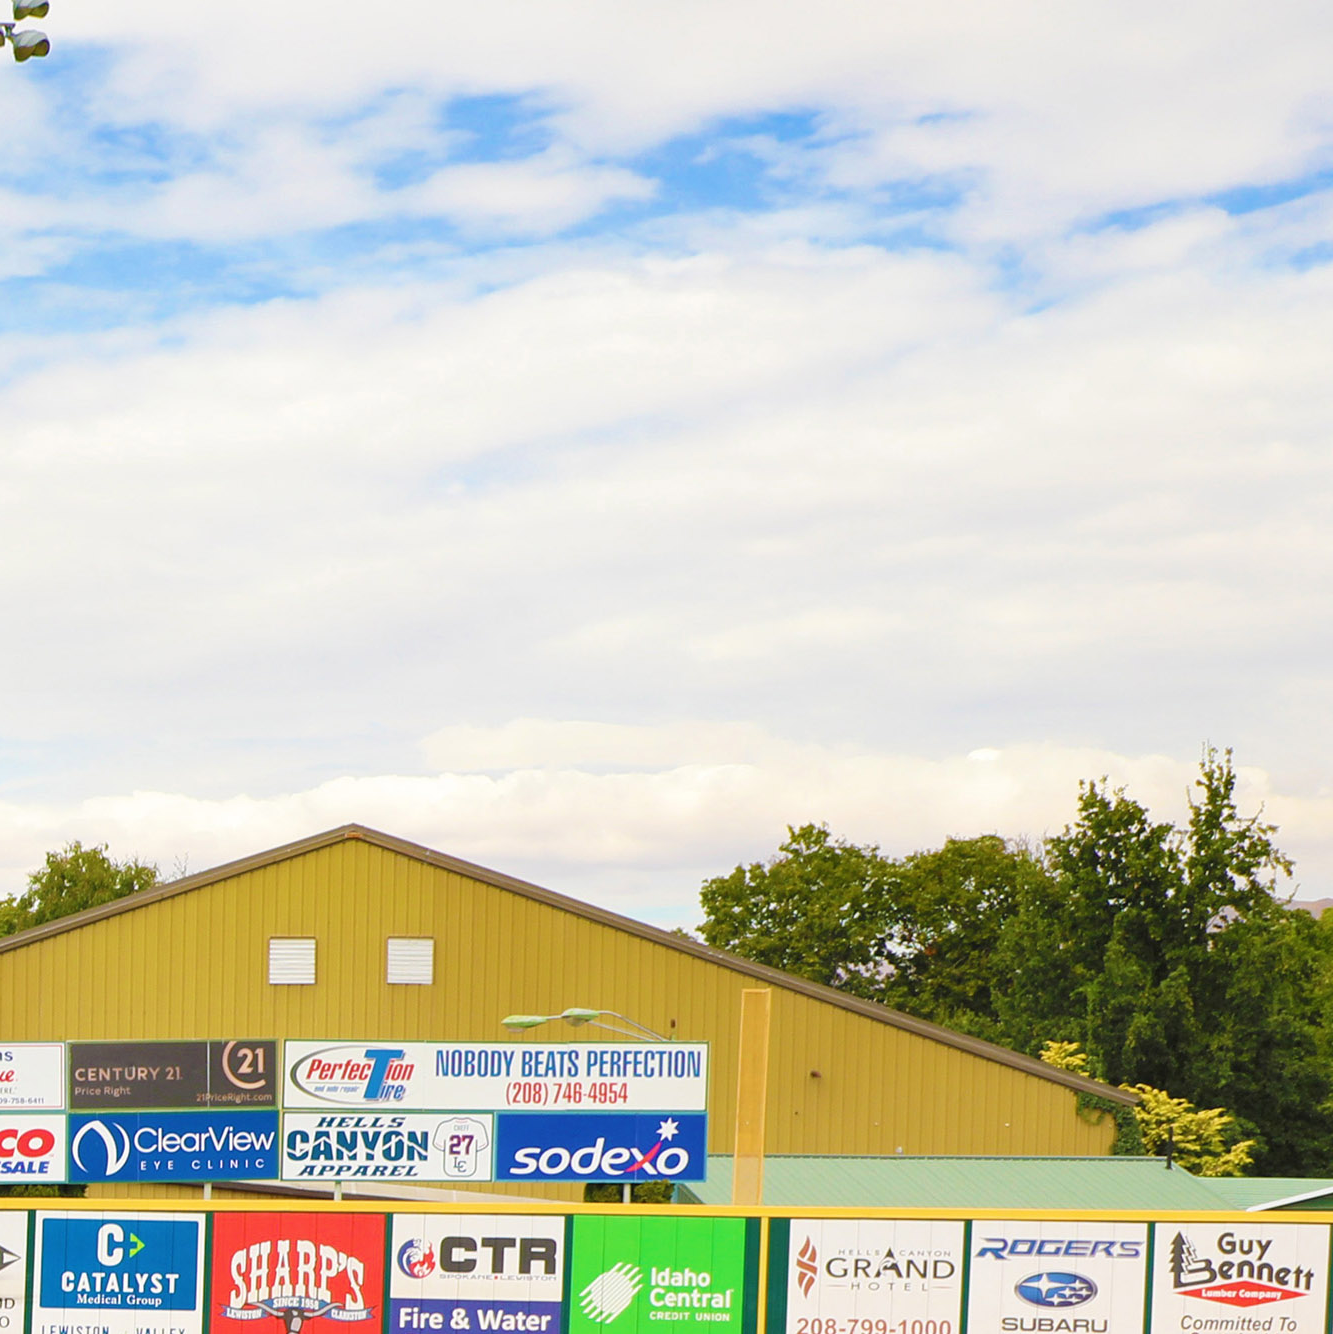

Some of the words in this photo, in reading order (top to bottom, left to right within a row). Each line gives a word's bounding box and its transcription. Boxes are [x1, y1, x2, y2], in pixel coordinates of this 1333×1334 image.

[75, 1067, 160, 1082] CENTURY
[166, 1066, 181, 1080] 21
[435, 1050, 515, 1078] NOBODY
[521, 1050, 579, 1078] BEATS
[586, 1050, 701, 1079] PERFECTION
[75, 1086, 102, 1096] Price
[104, 1086, 132, 1098] Right
[506, 1082, 549, 1106] (208)
[553, 1082, 629, 1104] 746-4954
[316, 1116, 407, 1128] HELLS
[286, 1130, 429, 1161] CANYON
[449, 1134, 474, 1155] 27
[140, 1160, 175, 1171] EYE
[191, 1158, 265, 1169] CLINIC
[510, 1137, 689, 1176] sodexo
[300, 1164, 419, 1177] APPAREL
[439, 1236, 558, 1275] CTR
[899, 1249, 952, 1257] CANYON
[974, 1236, 1145, 1260] ROGERS
[1217, 1233, 1272, 1259] Guy
[825, 1247, 956, 1280] GRAND
[61, 1271, 180, 1294] CATALYST
[230, 1238, 365, 1310] SHARP'S
[650, 1266, 711, 1287] Idaho
[1179, 1259, 1315, 1290] Bennett
[850, 1282, 929, 1292] HOTEL
[1202, 1288, 1237, 1300] Lumber
[1238, 1289, 1283, 1302] Company
[76, 1294, 122, 1306] Medical
[126, 1295, 162, 1308] Group
[272, 1296, 300, 1308] SINCE
[650, 1288, 731, 1309] Central
[226, 1307, 263, 1319] LEWISTON
[330, 1308, 367, 1321] CLARKSTON
[399, 1308, 444, 1330] Fire
[450, 1308, 471, 1330] &
[477, 1308, 552, 1332] Water
[649, 1311, 691, 1321] CREDIT
[695, 1311, 731, 1322] UNION
[1001, 1317, 1108, 1333] SUBARU
[1180, 1314, 1269, 1332] Committed
[1274, 1315, 1298, 1332] To
